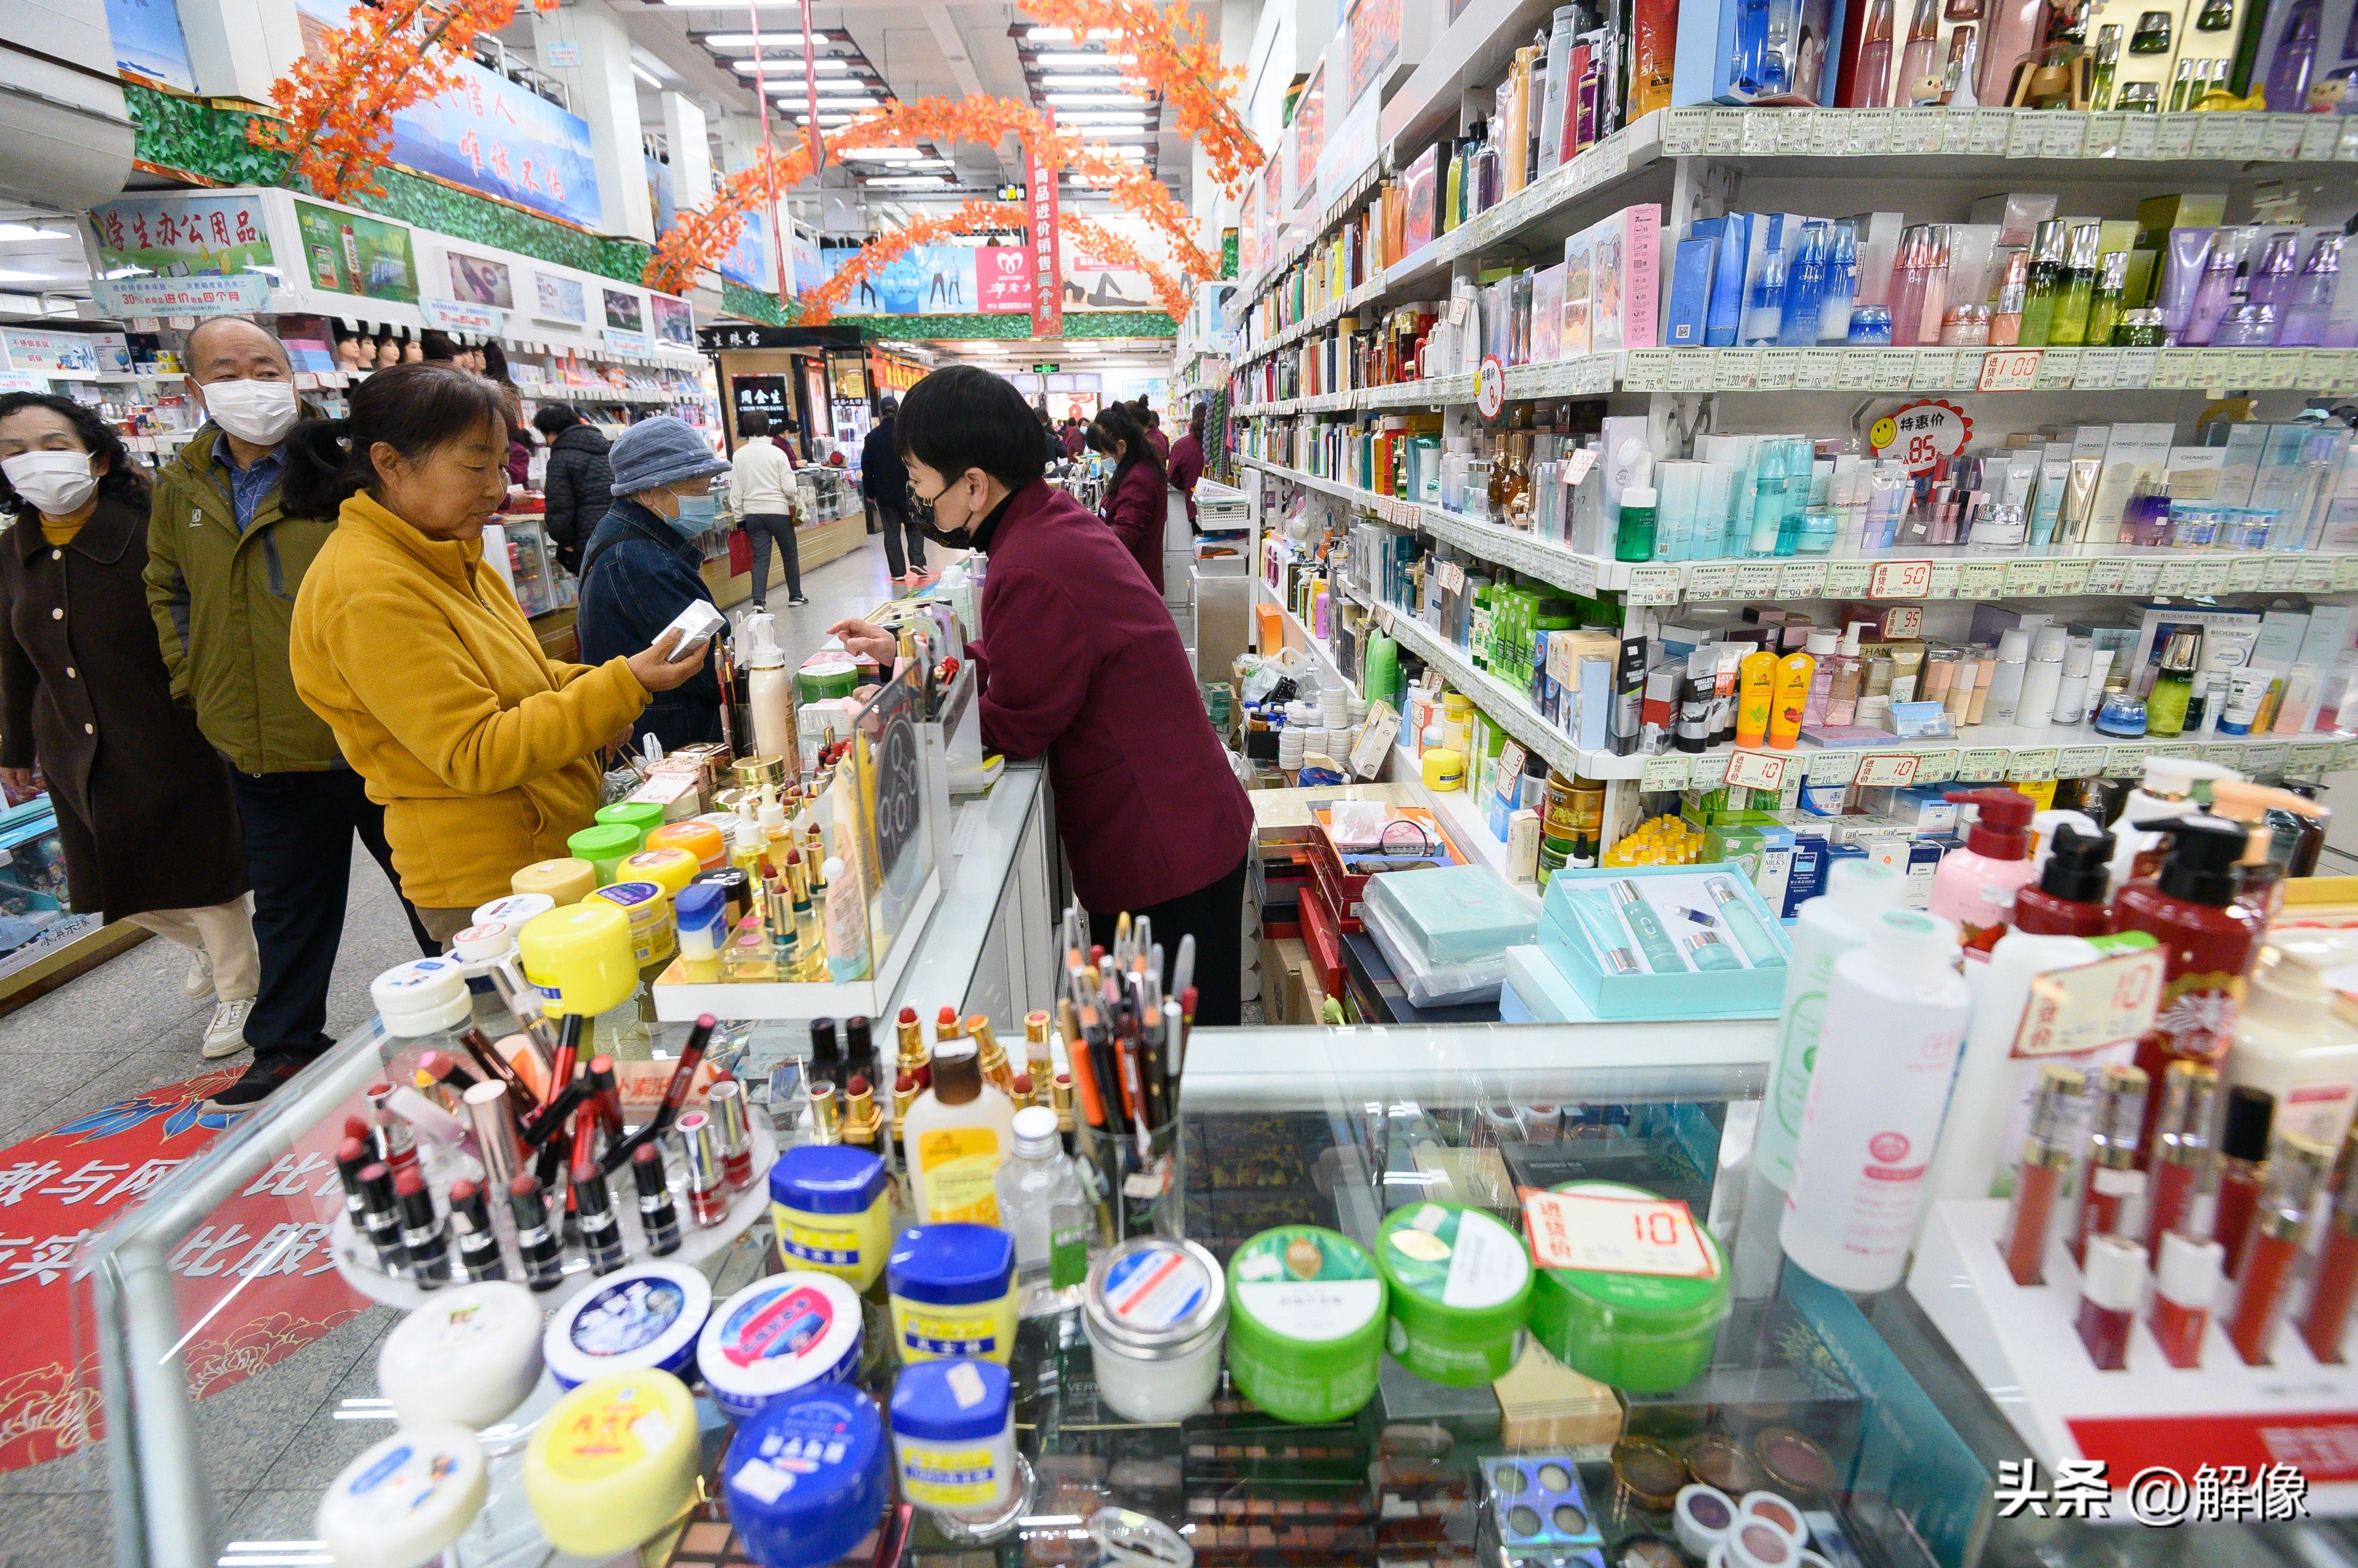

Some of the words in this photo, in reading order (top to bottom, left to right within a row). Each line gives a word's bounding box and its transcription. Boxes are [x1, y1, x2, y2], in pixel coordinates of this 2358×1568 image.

[105, 210, 258, 252] 学生办公用品
[1984, 356, 1998, 387] 进货价
[1999, 357, 2037, 377] 100
[1645, 378, 1663, 390] 75.00
[1726, 375, 1748, 386] 120.00
[1773, 374, 1794, 385] 120.00
[1851, 374, 1870, 386] 120.00
[1886, 374, 1908, 387] 125.00
[741, 389, 781, 404] 周金生
[1900, 412, 1945, 432] 特惠价
[1875, 567, 1887, 595] 进货价
[1903, 567, 1926, 584] 50
[1699, 590, 1719, 600] 99.00
[1744, 589, 1765, 598] 89.00
[1789, 589, 1810, 598] 99.00
[1841, 586, 1860, 596] 168.00
[1887, 609, 1896, 636] 进货价
[1905, 611, 1920, 627] 95
[1730, 755, 1745, 782] 进货价
[1762, 763, 1778, 779] 10
[1860, 760, 1874, 783] 进货价
[1893, 761, 1912, 776] 10
[1658, 779, 1675, 789] 3.00
[1634, 1212, 1677, 1245] 10
